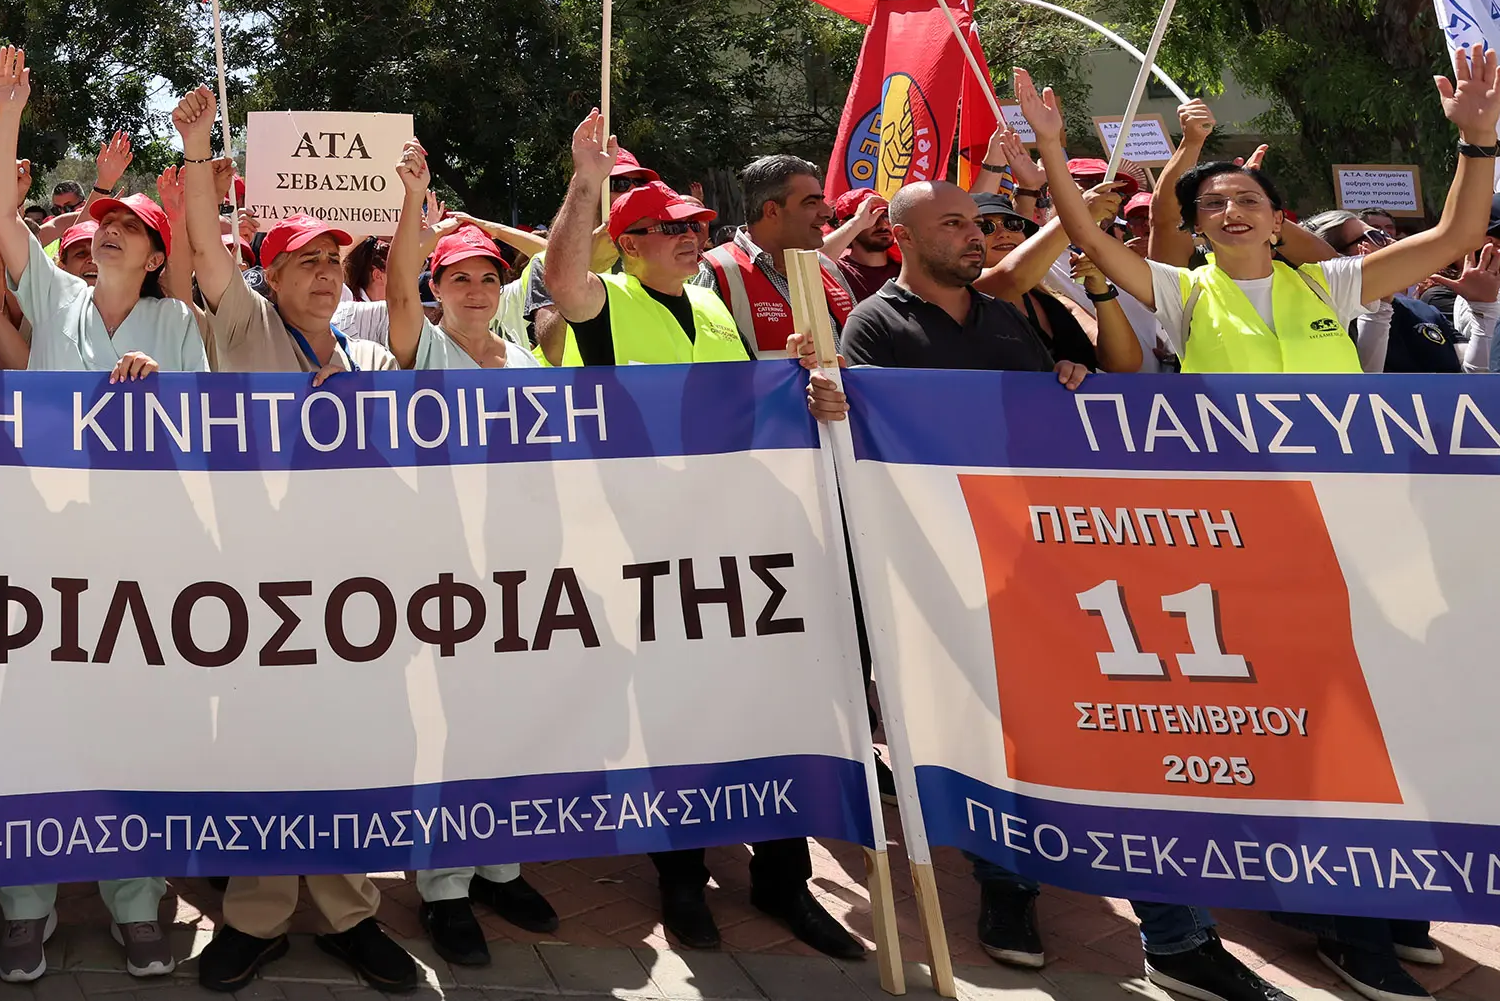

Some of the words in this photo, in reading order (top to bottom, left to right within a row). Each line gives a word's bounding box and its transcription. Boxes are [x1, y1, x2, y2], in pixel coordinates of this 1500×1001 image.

[291, 131, 373, 160] ΑΤΑ
[276, 172, 387, 193] ΣΕΒΑΣΜΟ
[250, 204, 280, 220] ΣΤΑ
[282, 205, 403, 223] ΣΥΜΦΩΝΗΘΕΝΤ
[73, 384, 609, 453] ΚΙΝΗΤΟΠΟΙΗΣΗ
[1074, 393, 1500, 455] ΠΑΝΣΥΝΔ
[1028, 505, 1245, 548] ΠΕΜΠΤΗ
[622, 552, 805, 643] ΤΗΣ
[1075, 579, 1257, 683] 11
[1073, 701, 1310, 738] ΣΕΠΤΕΜΒΡΙΟΥ
[1162, 754, 1256, 786] 2025
